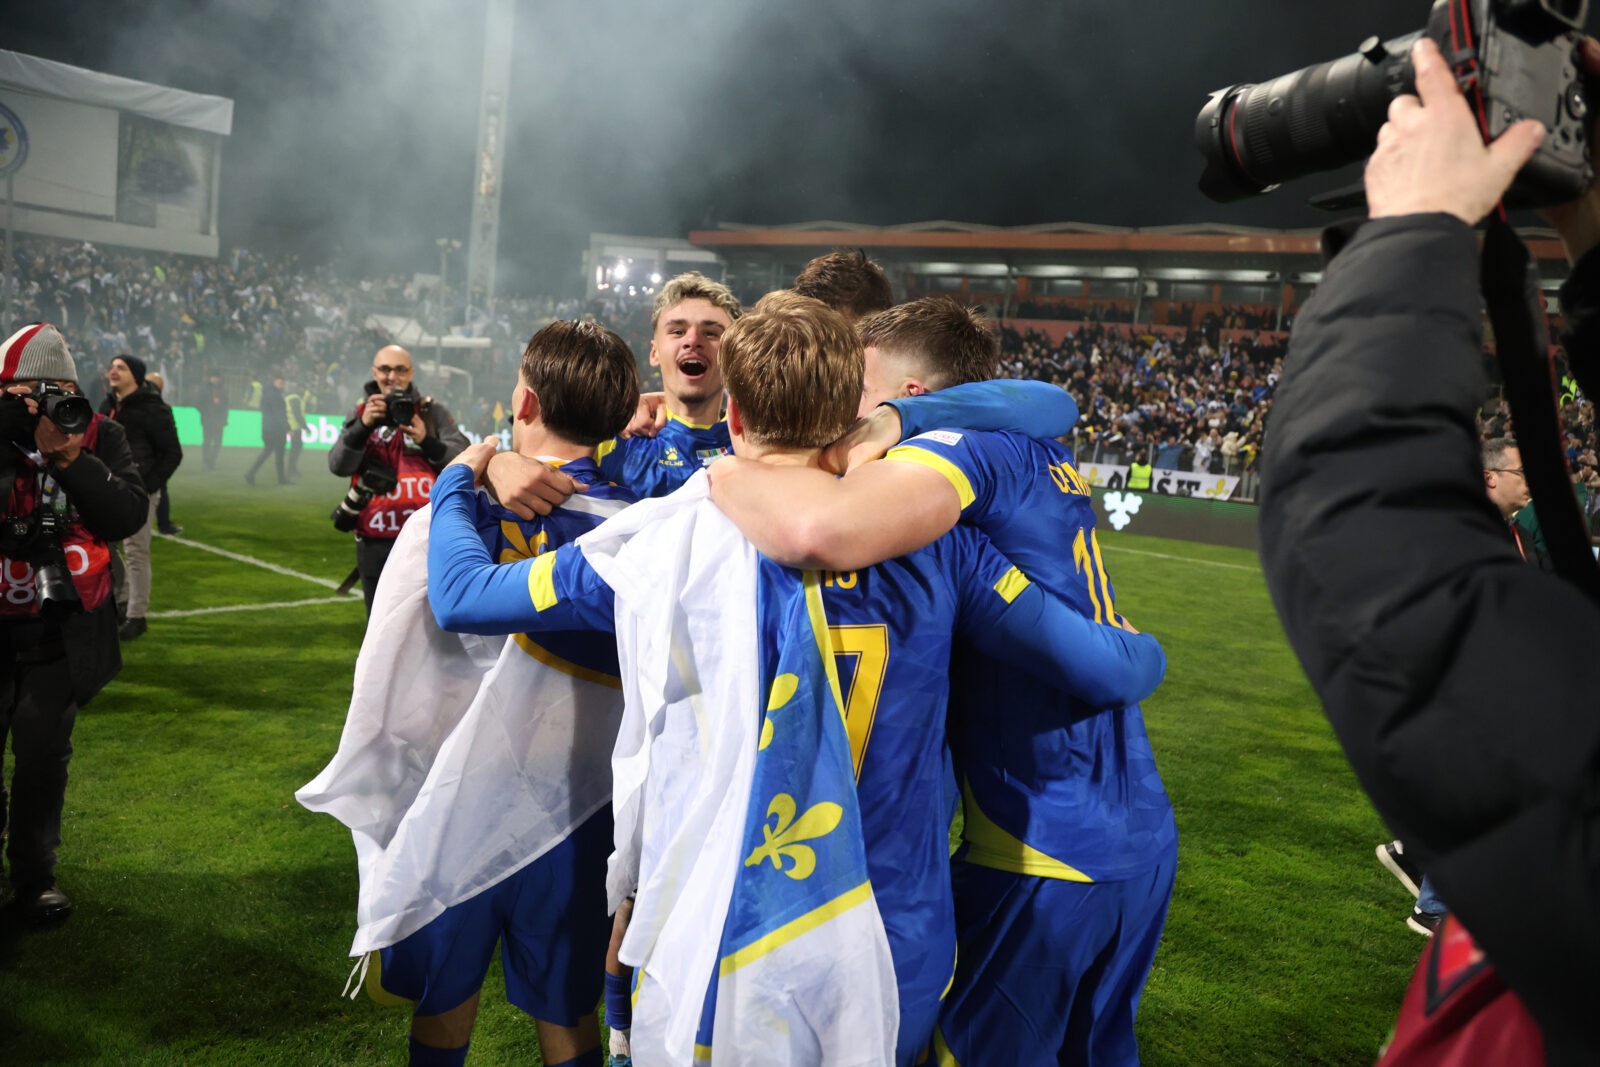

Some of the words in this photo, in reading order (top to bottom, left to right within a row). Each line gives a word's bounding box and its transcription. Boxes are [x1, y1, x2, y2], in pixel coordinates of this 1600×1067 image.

[372, 477, 433, 501] OTO
[368, 508, 416, 532] 41
[828, 623, 890, 787] 7
